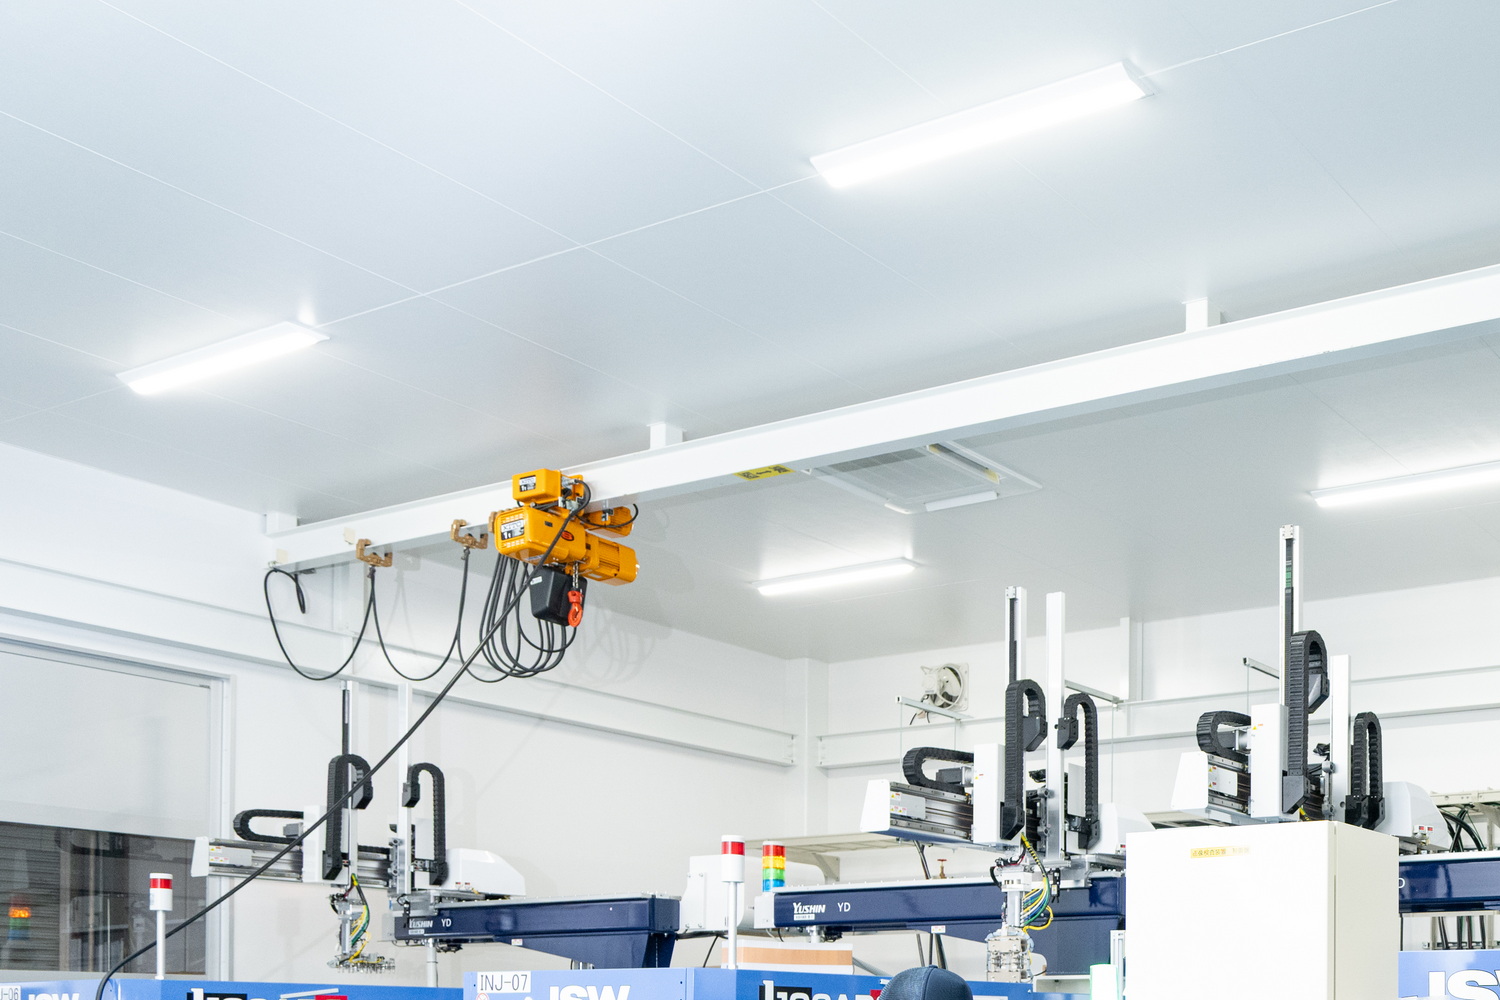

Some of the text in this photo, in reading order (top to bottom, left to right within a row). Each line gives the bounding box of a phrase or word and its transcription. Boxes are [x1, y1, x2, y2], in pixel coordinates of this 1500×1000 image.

[794, 902, 851, 914] YUSHIN YD
[409, 918, 452, 929] YUSHIN YD
[480, 974, 528, 991] INJ-07
